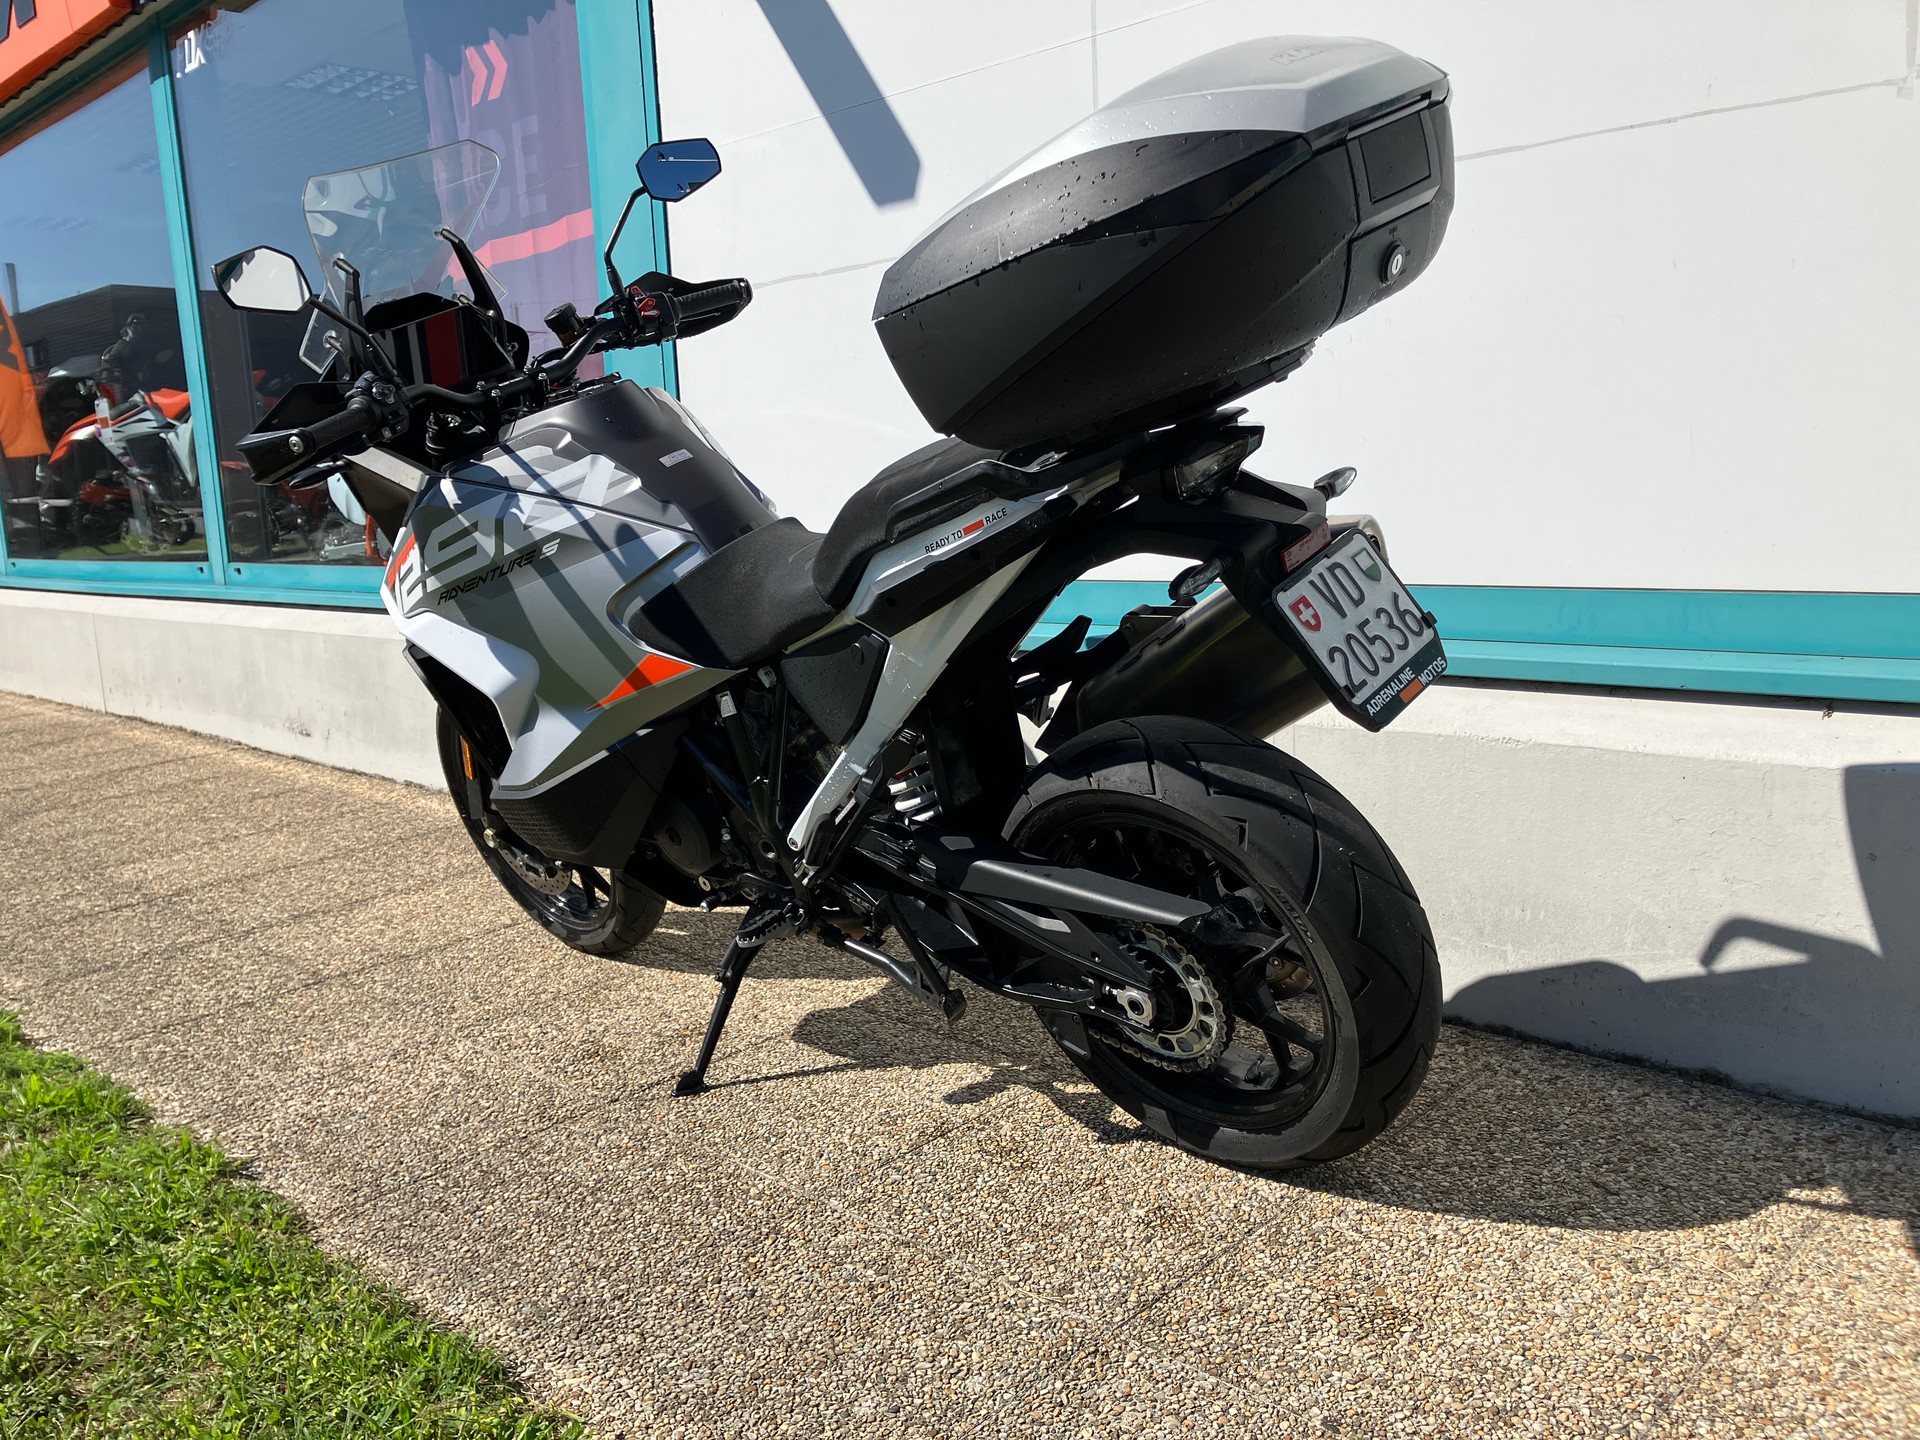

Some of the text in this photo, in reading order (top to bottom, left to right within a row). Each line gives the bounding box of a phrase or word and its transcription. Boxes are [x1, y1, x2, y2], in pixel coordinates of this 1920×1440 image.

[924, 507, 1007, 554] READY TO RACE
[437, 549, 537, 606] ADVENTURE
[539, 538, 561, 560] S
[1308, 561, 1366, 620] VD
[1328, 591, 1425, 694] 20536
[1366, 656, 1447, 717] ADRENALINE MOTOS
